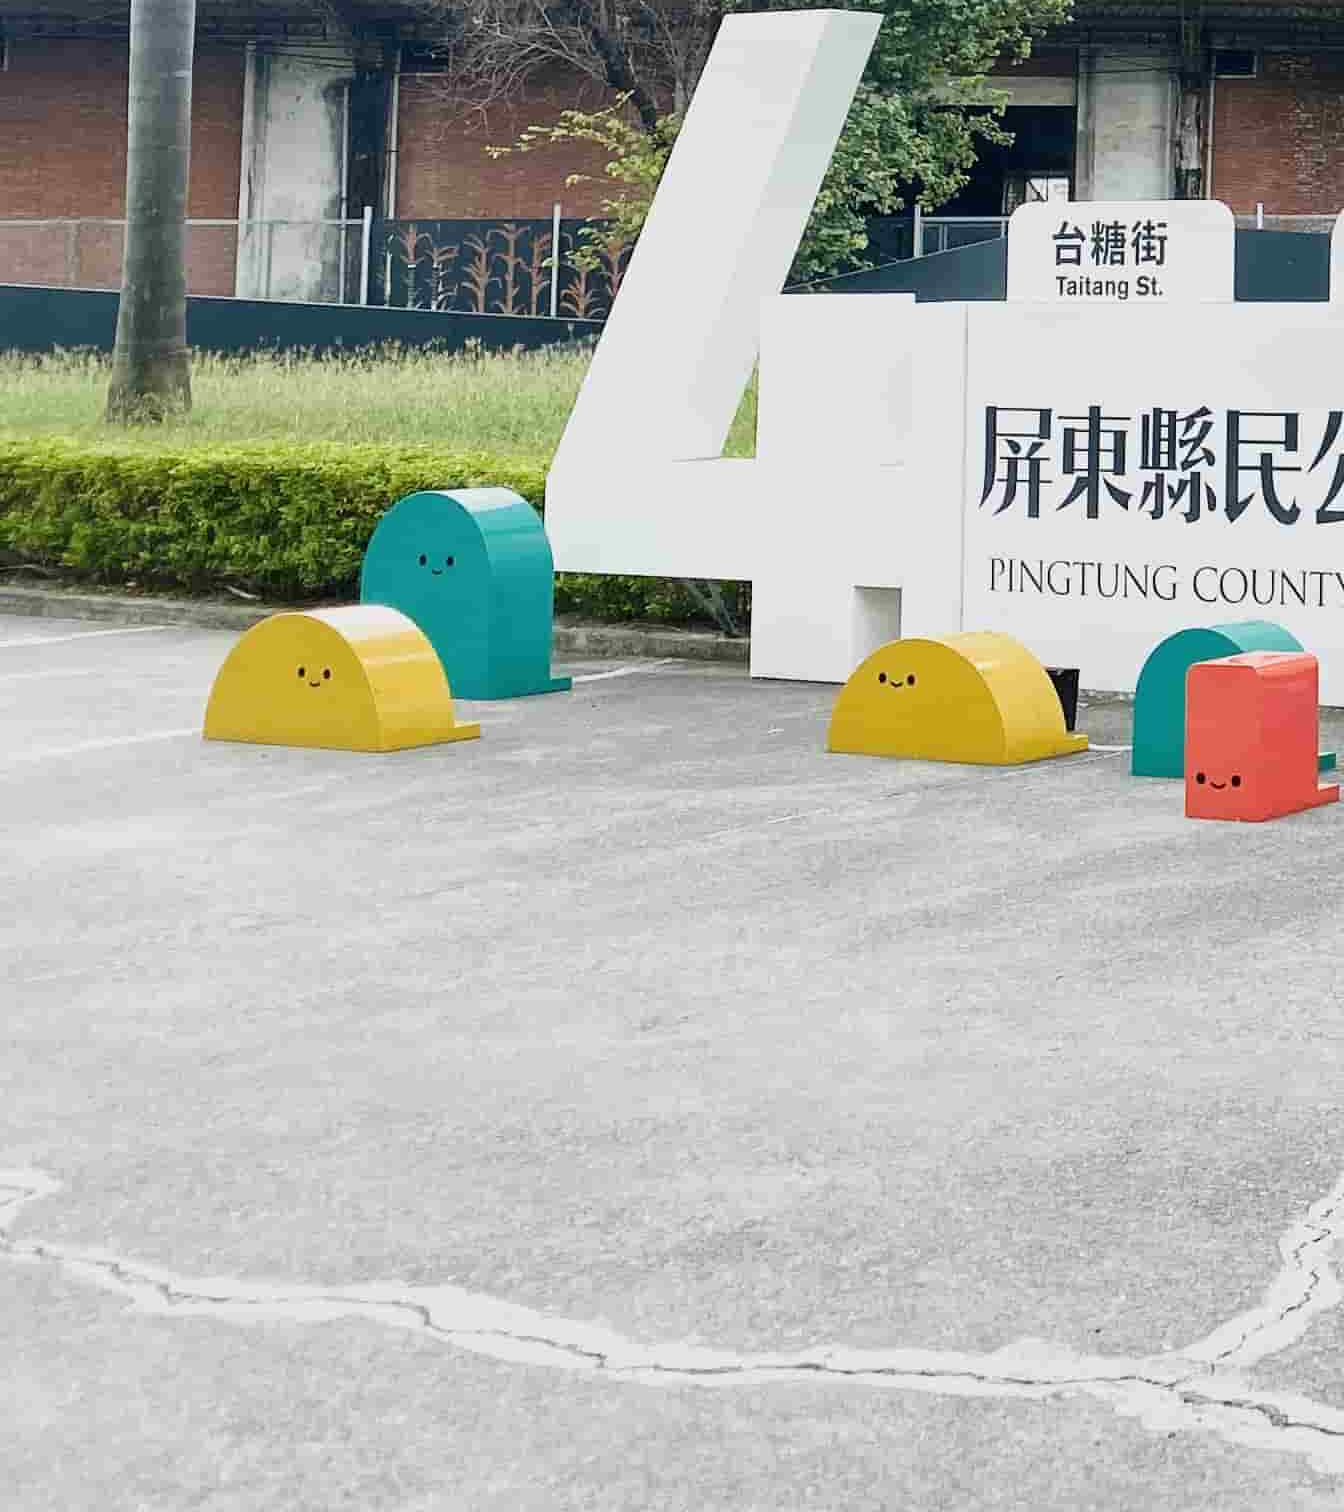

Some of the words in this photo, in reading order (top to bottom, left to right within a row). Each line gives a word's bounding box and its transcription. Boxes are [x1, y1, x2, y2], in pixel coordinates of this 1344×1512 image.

[1052, 220, 1168, 266] 台糖街
[1056, 276, 1128, 300] Taitang
[1136, 275, 1163, 296] St.
[989, 558, 1178, 601] PINGTUNG
